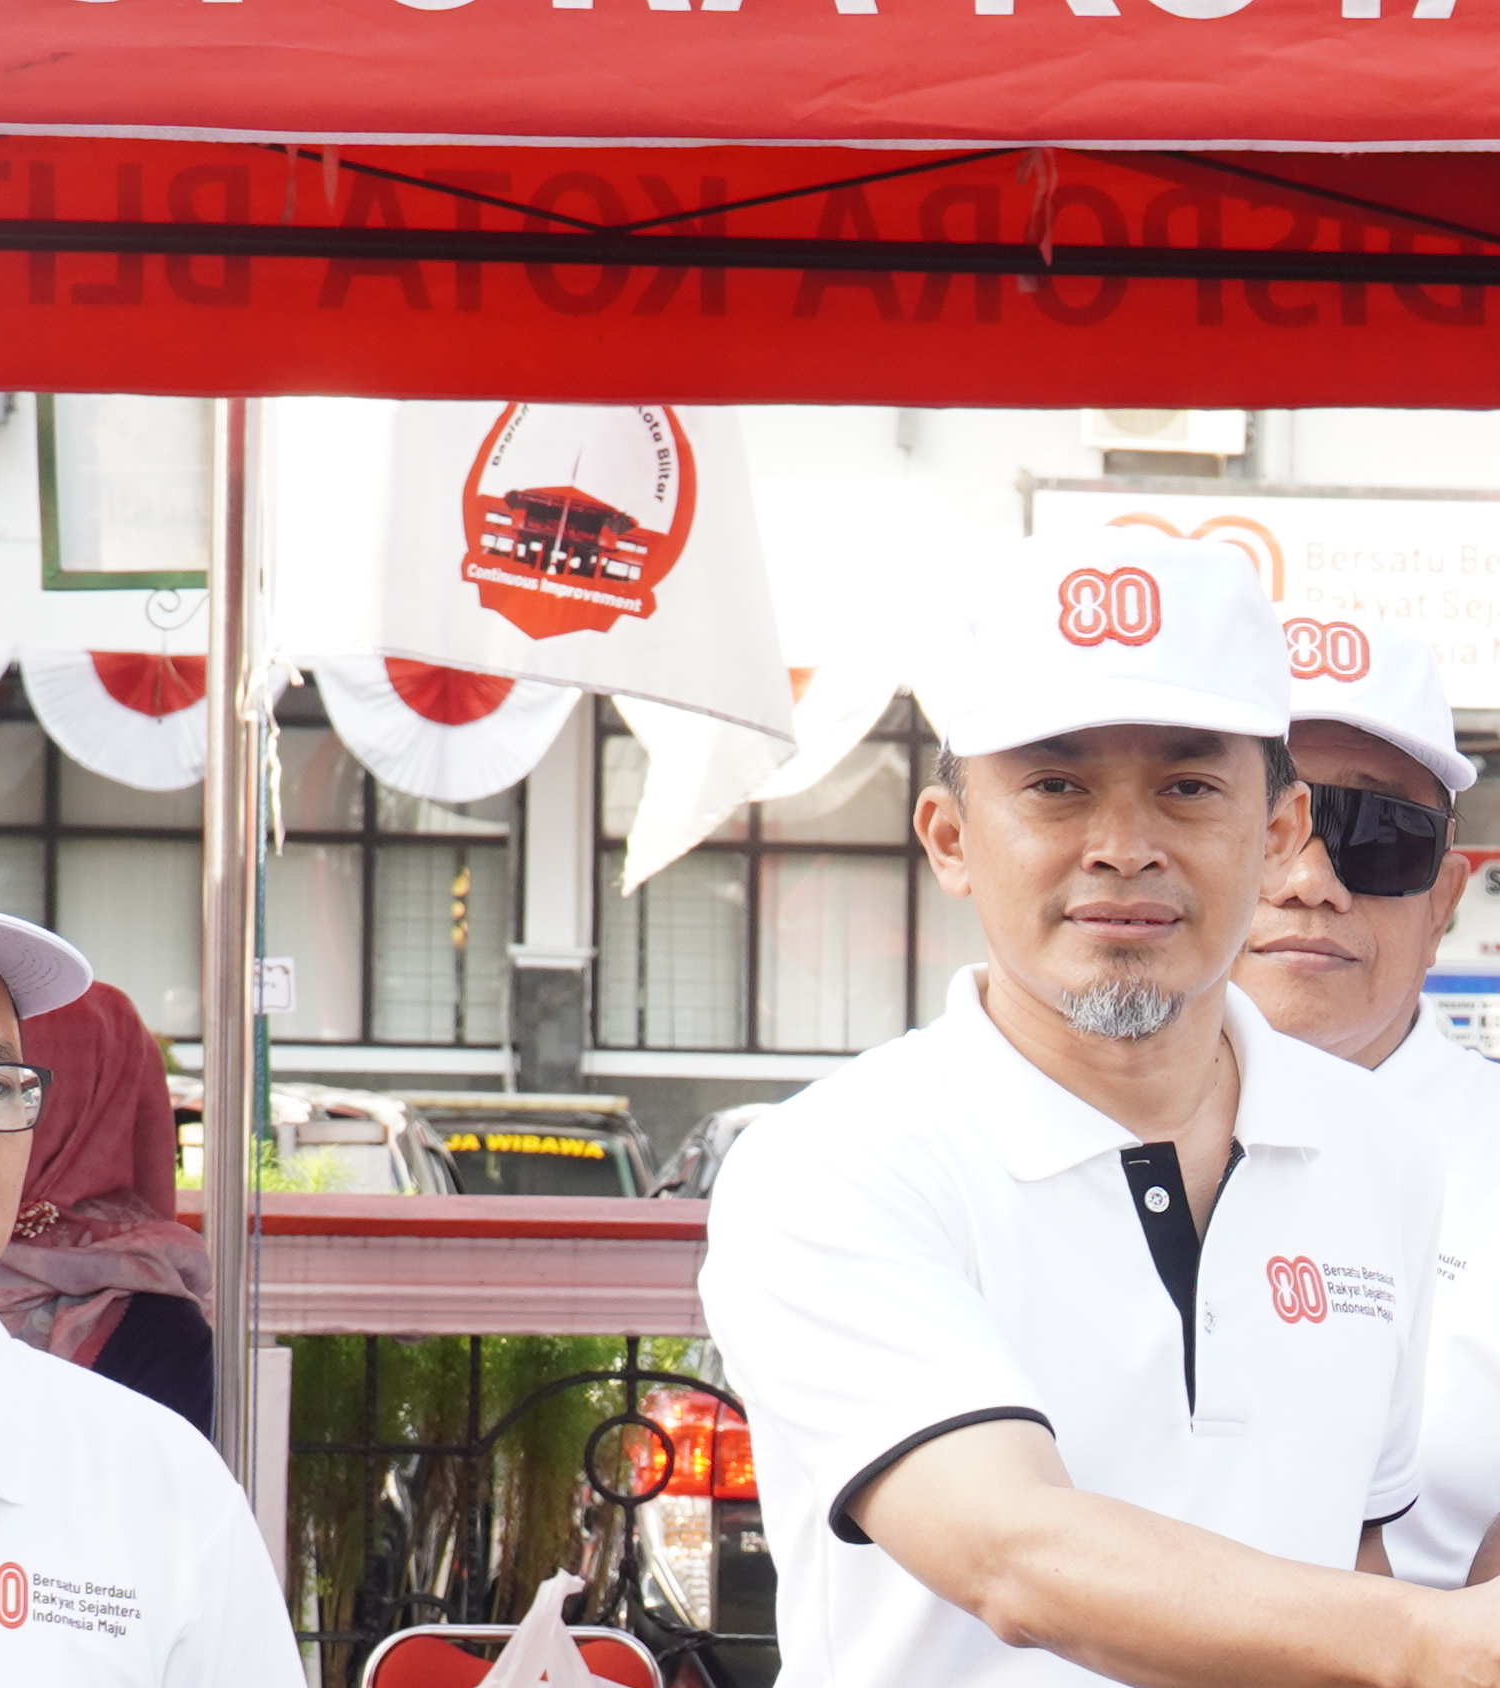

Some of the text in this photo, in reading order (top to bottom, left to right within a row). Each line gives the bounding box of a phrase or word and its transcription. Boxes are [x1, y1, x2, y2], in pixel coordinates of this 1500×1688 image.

[653, 447, 672, 503] Blitar
[1306, 541, 1445, 574] Bersatu
[466, 563, 644, 613] Continuous Improvement
[1058, 566, 1161, 646] 80
[1283, 616, 1370, 683] 80
[486, 1133, 605, 1159] WIBAWA
[1266, 1255, 1328, 1324] 80
[33, 1573, 81, 1594] Bersatu
[33, 1591, 142, 1619] Rakyat Sejahtera
[33, 1609, 127, 1638] Indonesia Maju
